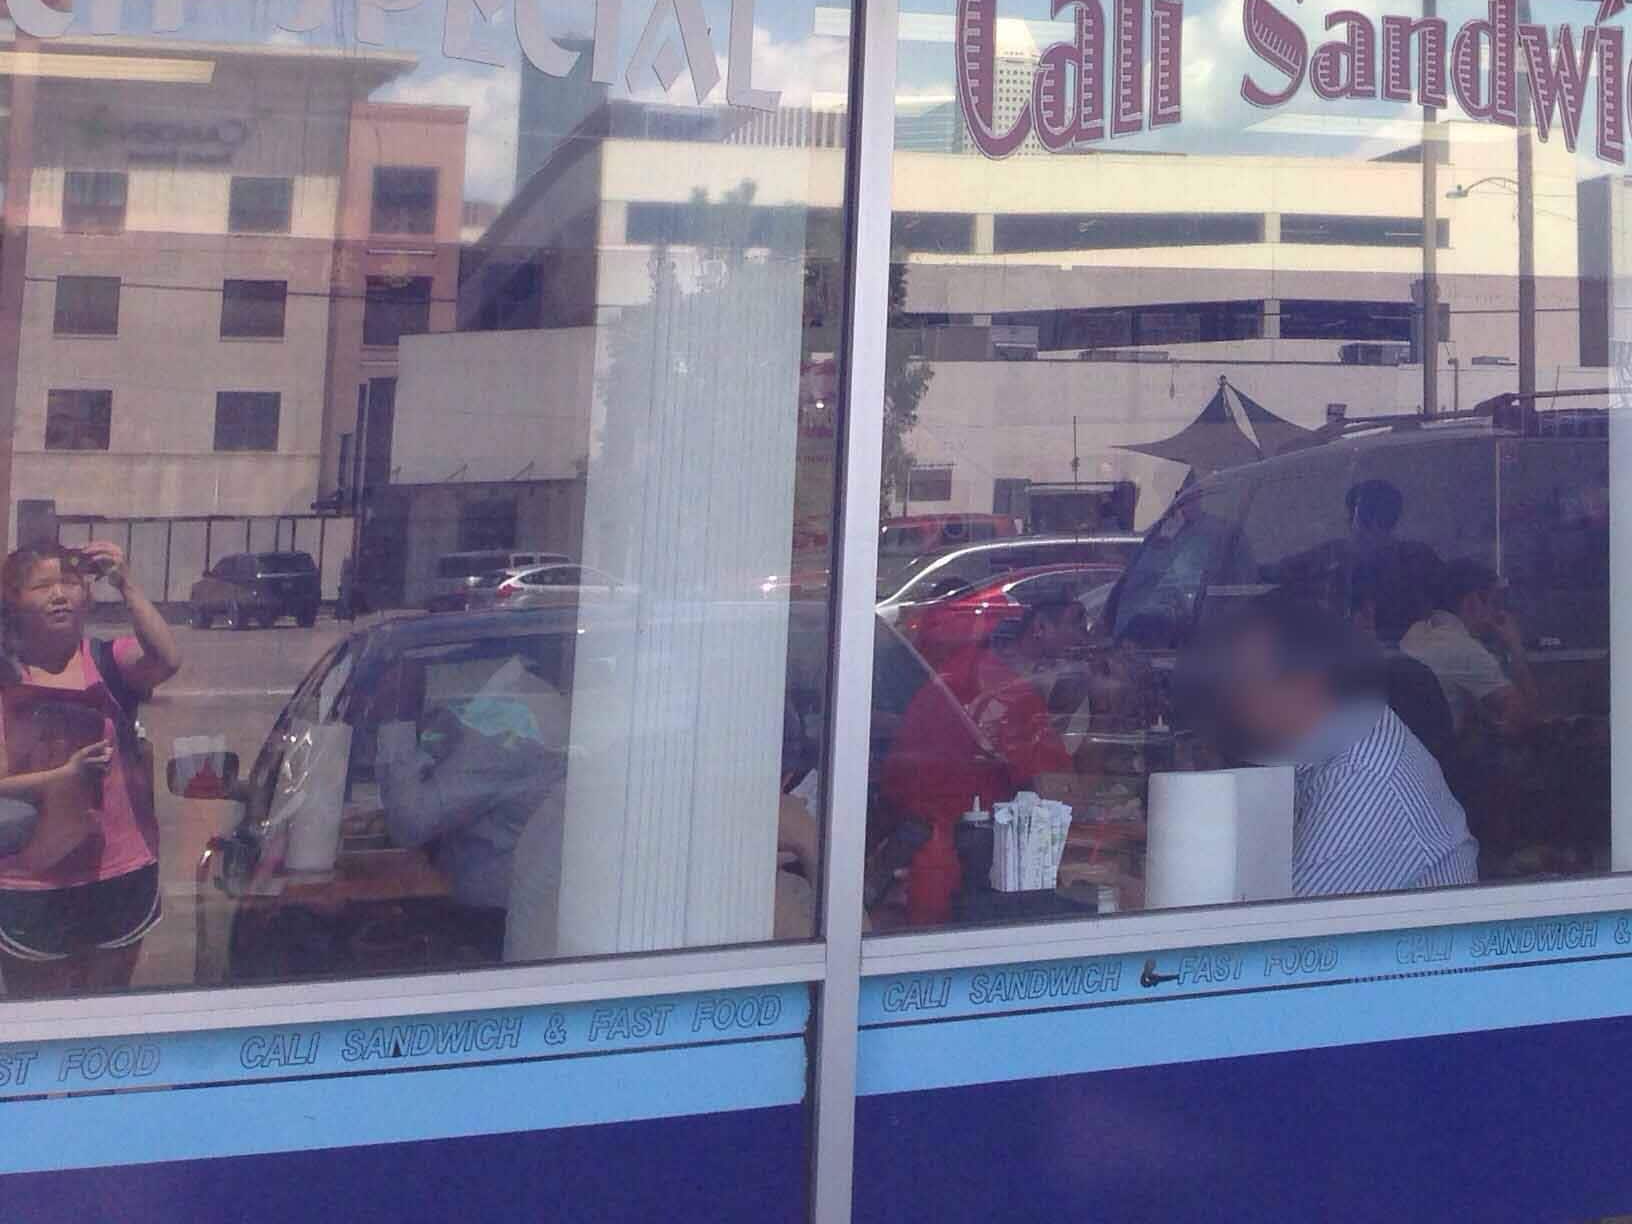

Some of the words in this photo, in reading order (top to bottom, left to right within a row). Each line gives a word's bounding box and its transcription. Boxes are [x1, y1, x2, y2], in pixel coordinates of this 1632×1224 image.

[1394, 933, 1456, 964] CALI
[1469, 918, 1599, 958] SANDWICH
[1613, 916, 1632, 945] &
[881, 976, 951, 1013] CALI
[968, 960, 1122, 1005] SANDWICH
[1264, 942, 1340, 978] FOOD
[239, 1031, 321, 1069] CALI
[341, 1015, 523, 1063] SANDWICH
[543, 1010, 569, 1046] &
[588, 1002, 675, 1042] FAST
[691, 991, 785, 1033] FOOD
[57, 1042, 162, 1083] FOOD
